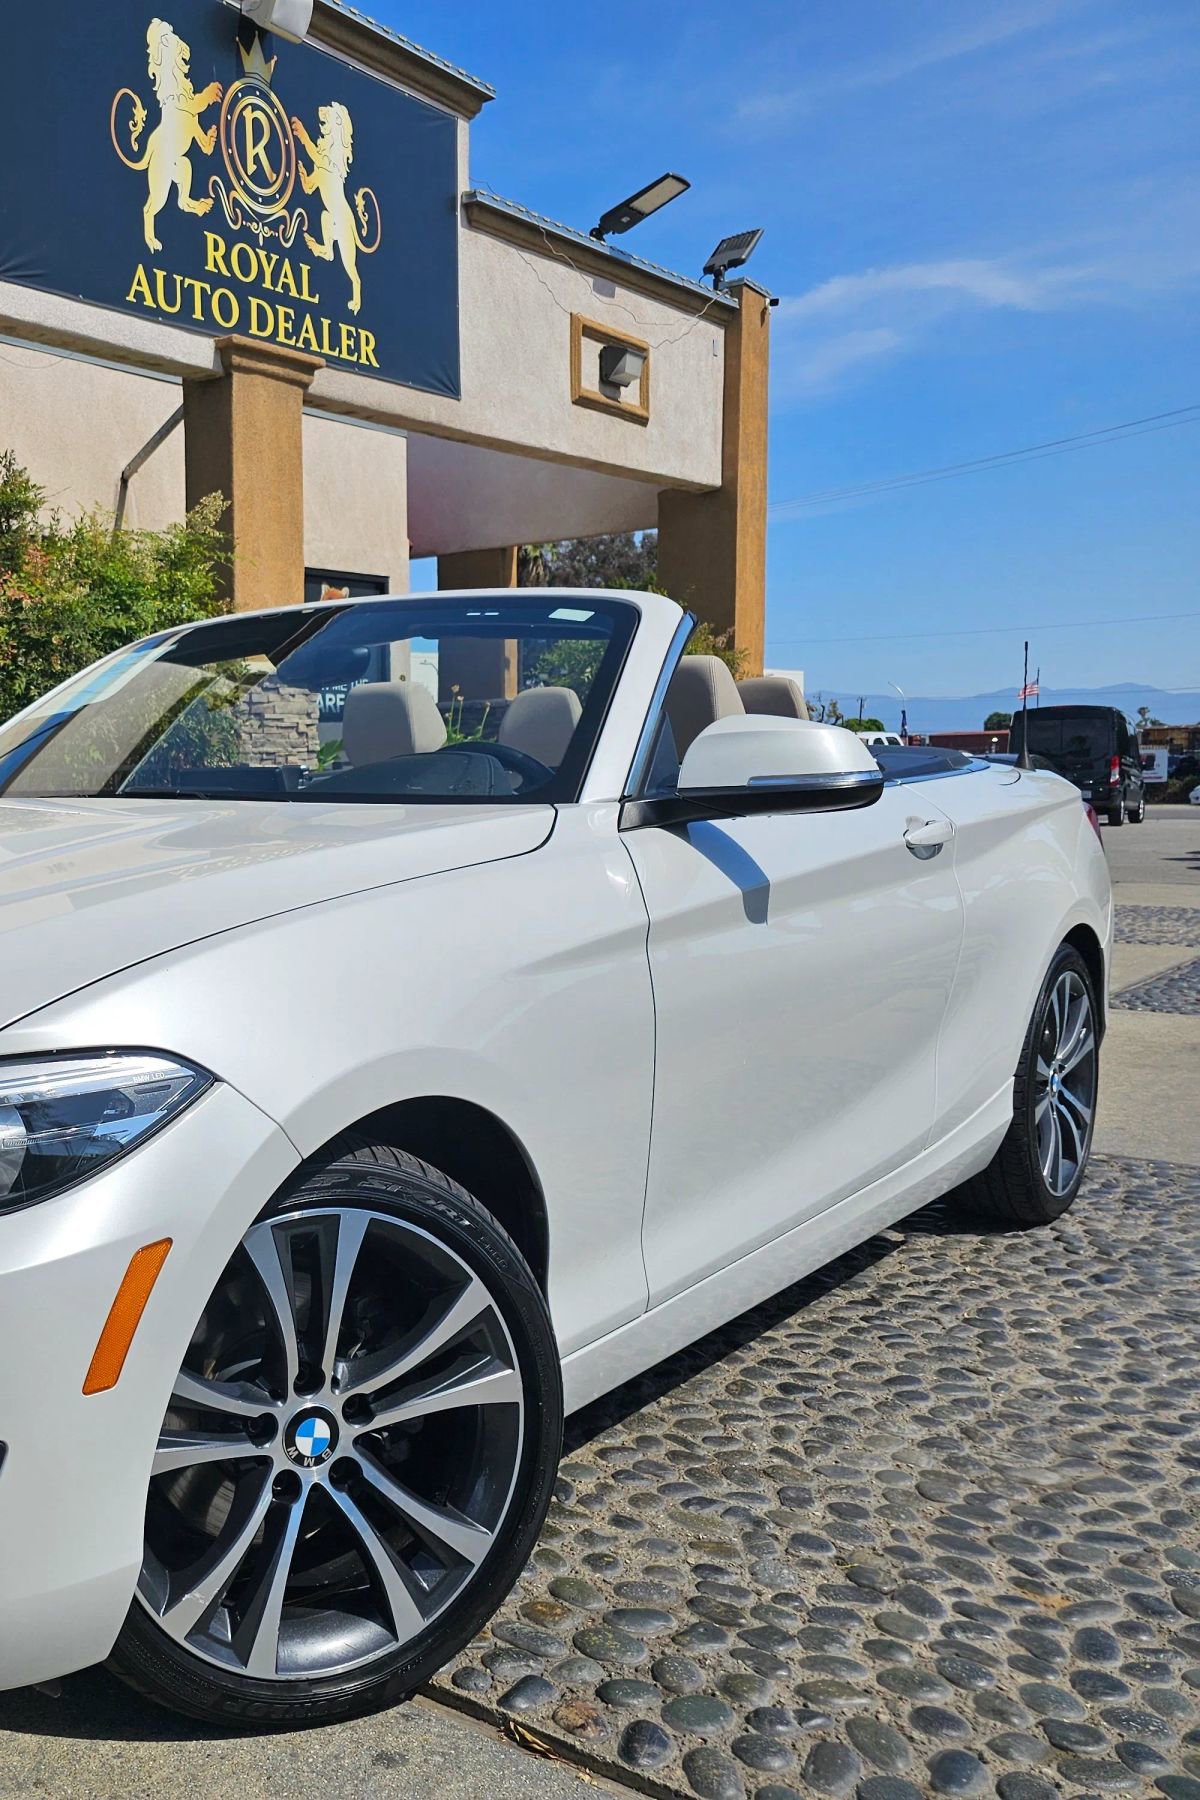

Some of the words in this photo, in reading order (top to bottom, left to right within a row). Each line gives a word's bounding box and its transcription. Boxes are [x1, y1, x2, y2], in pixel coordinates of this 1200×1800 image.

[242, 104, 277, 183] R
[204, 230, 320, 304] ROYAL
[126, 263, 240, 328] AUTO
[248, 296, 380, 368] DEALER
[286, 1446, 333, 1467] BMW
